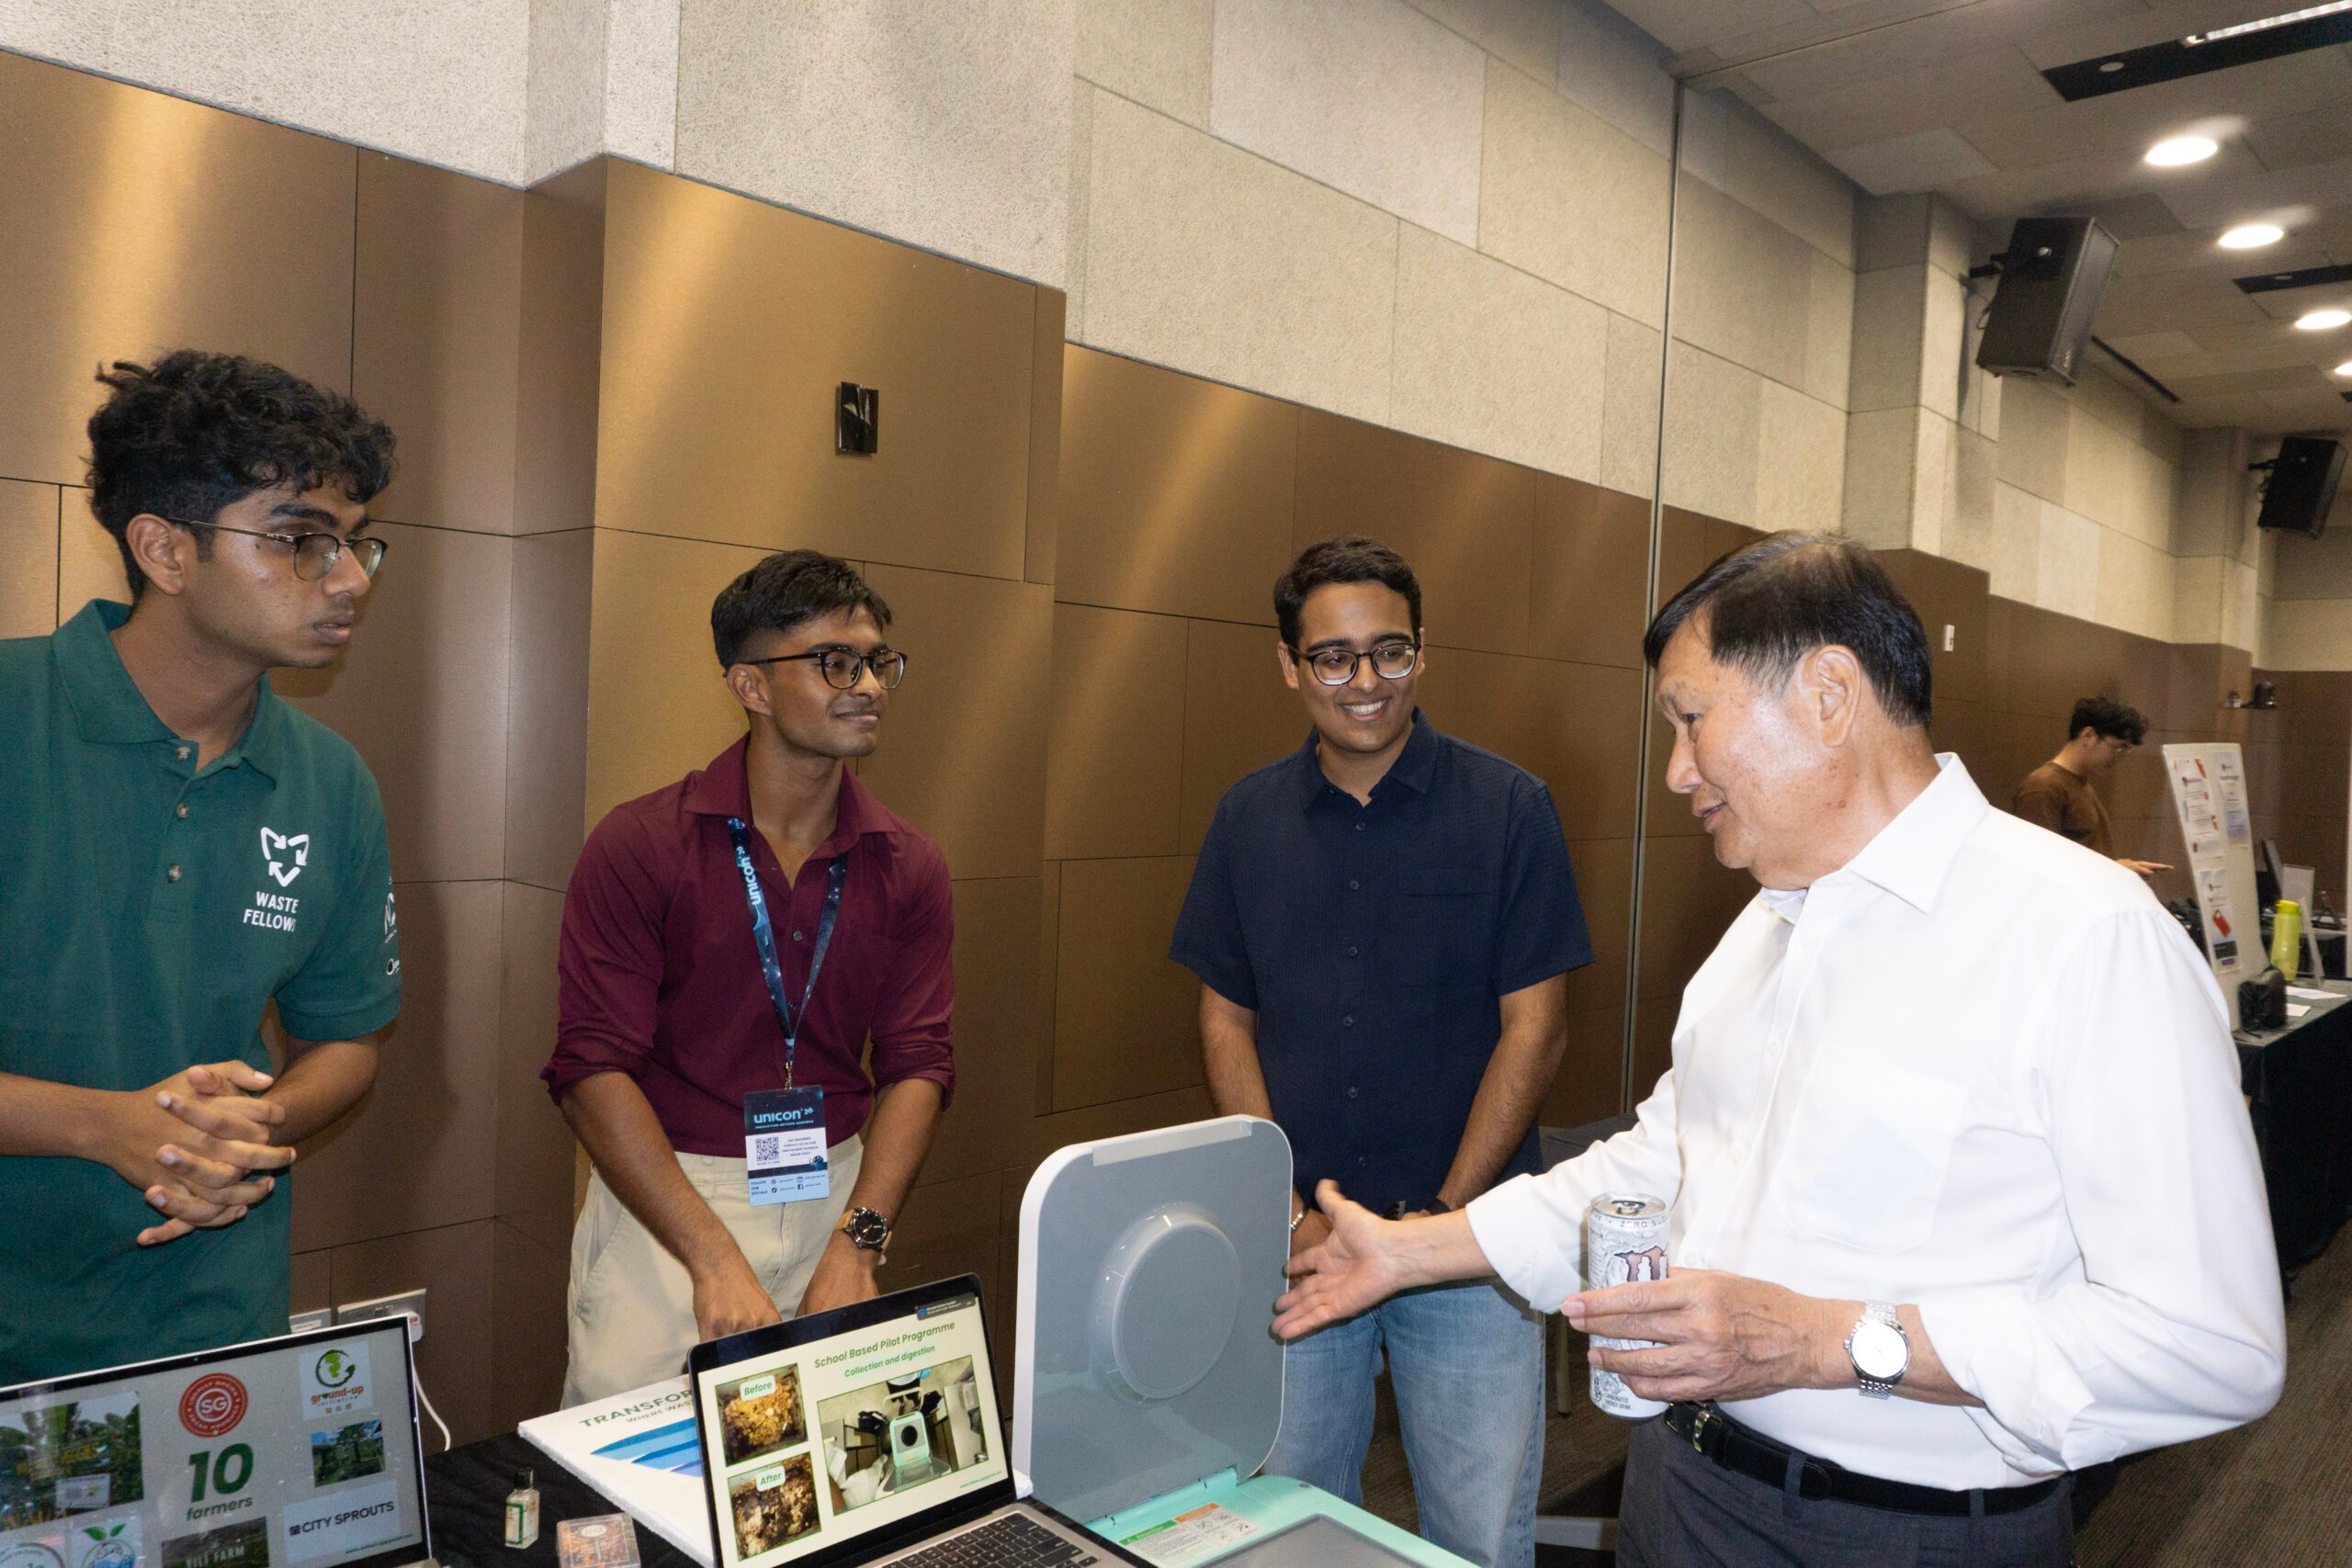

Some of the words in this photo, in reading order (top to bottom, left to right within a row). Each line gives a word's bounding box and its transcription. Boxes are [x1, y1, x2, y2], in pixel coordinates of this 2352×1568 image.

[255, 891, 300, 914] WASTE
[814, 1351, 848, 1369] School
[849, 1342, 878, 1359] Based
[880, 1337, 900, 1350] Pilot
[902, 1322, 956, 1344] Programme
[844, 1359, 884, 1378] Collection
[885, 1355, 900, 1367] and
[901, 1345, 935, 1362] digestion
[744, 1381, 773, 1396] Before
[200, 1396, 228, 1414] SG
[187, 1442, 254, 1504] 10
[760, 1472, 782, 1486] After
[186, 1496, 254, 1521] farmers
[301, 1516, 333, 1533] CITY
[334, 1500, 395, 1526] SPROUTS
[214, 1545, 244, 1562] FARM
